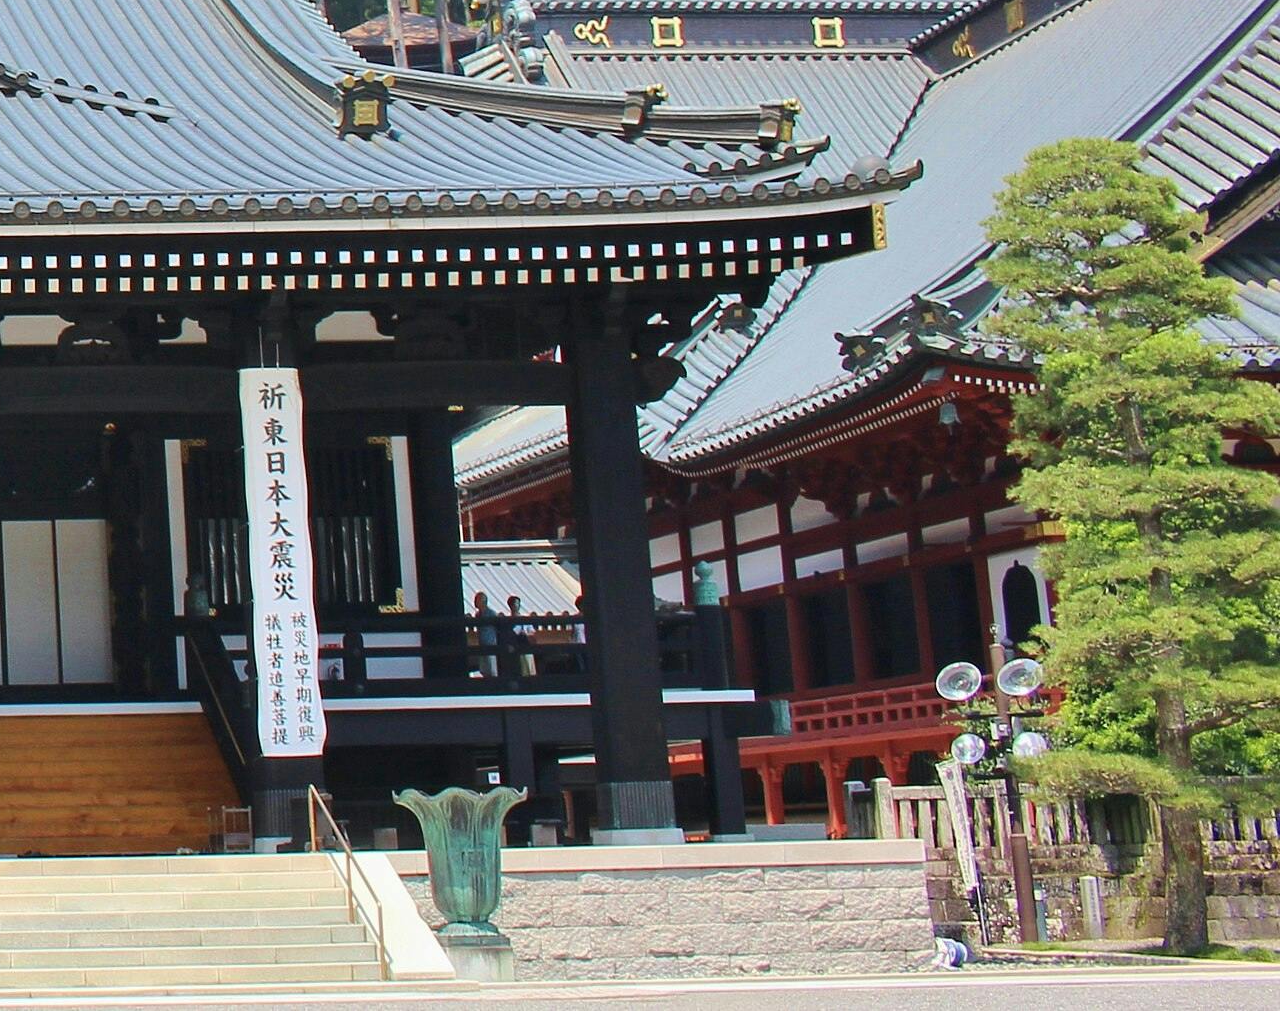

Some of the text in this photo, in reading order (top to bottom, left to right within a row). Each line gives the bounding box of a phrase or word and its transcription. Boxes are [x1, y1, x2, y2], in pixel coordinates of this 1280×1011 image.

[257, 382, 299, 601] 祈東日本大震災
[264, 613, 289, 745] 犠牲者追善菩提
[290, 611, 316, 742] 被災地早期復興
